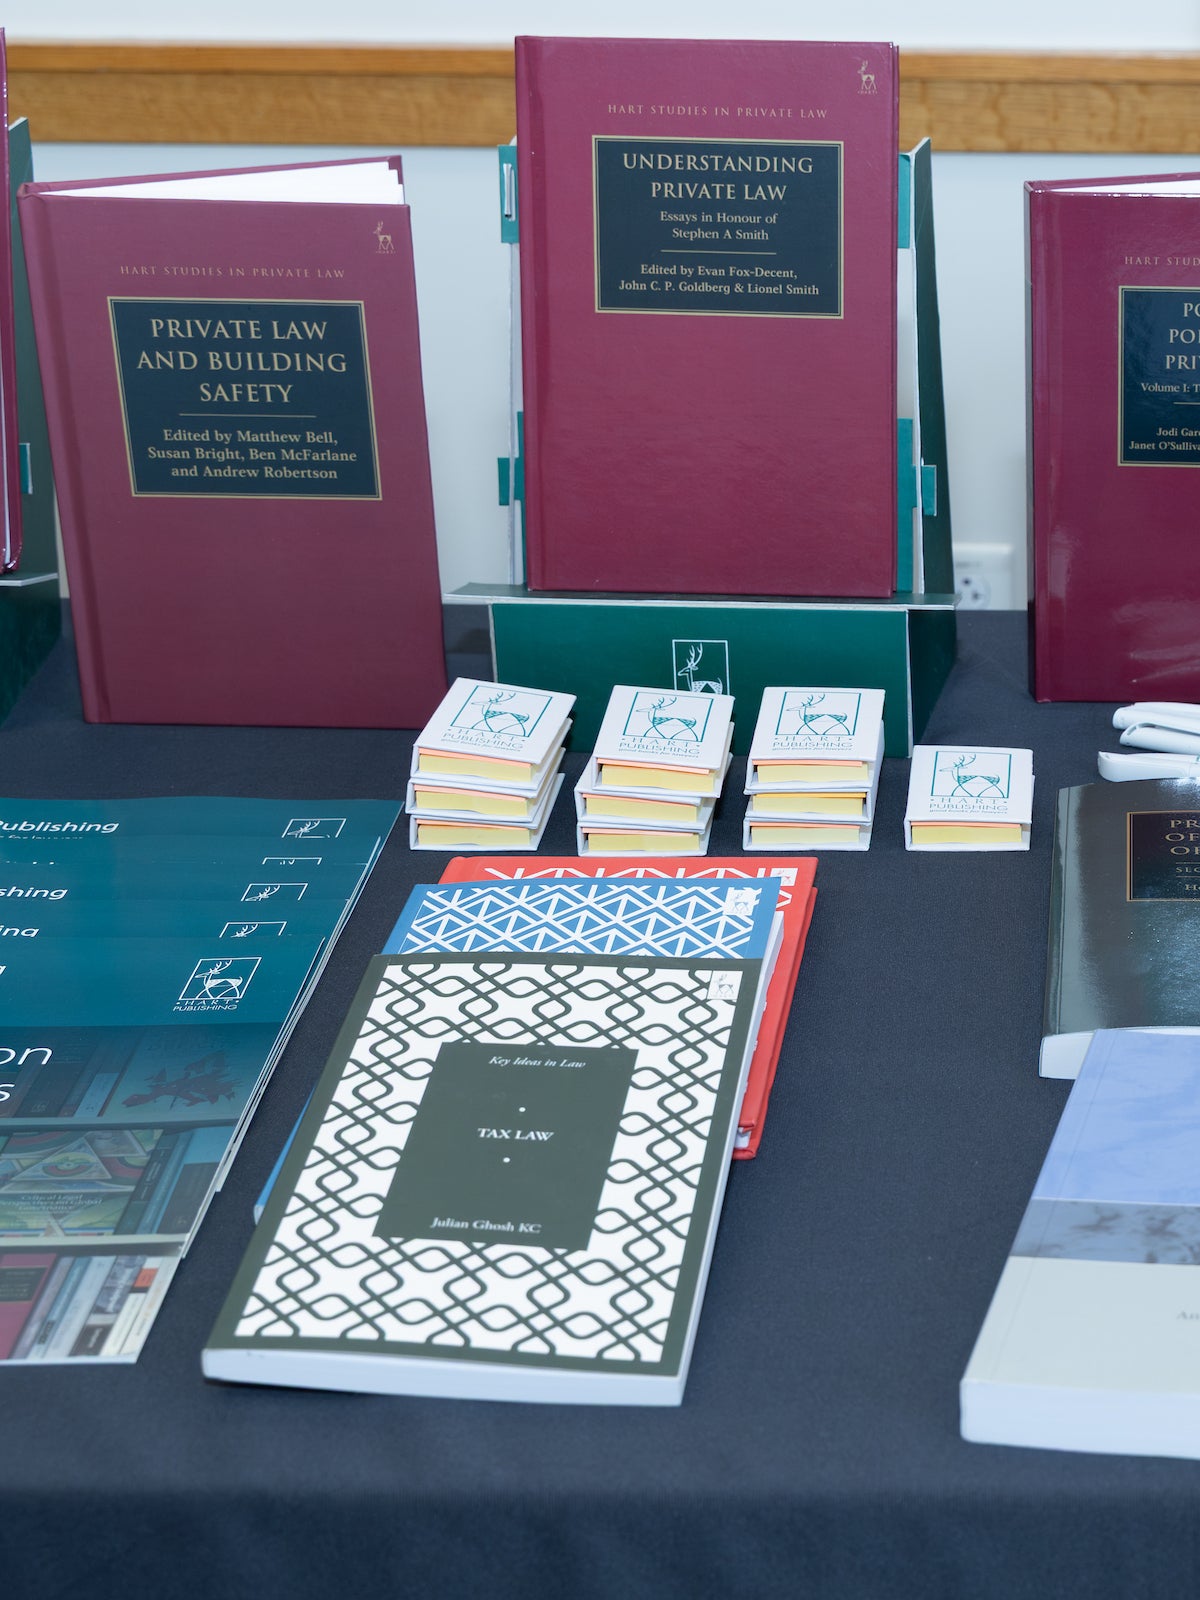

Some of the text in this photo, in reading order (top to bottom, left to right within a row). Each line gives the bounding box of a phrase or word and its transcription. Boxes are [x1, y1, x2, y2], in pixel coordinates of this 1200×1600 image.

[608, 105, 827, 118] HART STUDIES IN PRIVATE LAW
[623, 153, 814, 174] UNDERSTANDING
[651, 182, 786, 200] PRIVATE LAW
[660, 210, 778, 224] Essays in Honour of
[672, 227, 769, 241] Stephen A Smith
[640, 264, 798, 279] Edited by Evan Fox-Decent,
[619, 280, 819, 296] John C. P. Goldberg & Lionel Smith
[151, 318, 327, 341] PRIVATE LAW
[137, 352, 347, 374] AND BUILDING
[201, 383, 293, 404] SAFETY
[1141, 382, 1179, 393] Volume
[1183, 384, 1190, 393] I:
[163, 429, 338, 446] Edited by Matthew Bell,
[1156, 427, 1177, 437] Jodi
[1129, 440, 1156, 450] Janet
[148, 448, 357, 465] Susan Bright, Ben McFarlane
[171, 465, 338, 480] and Andrew Robertson
[489, 1056, 586, 1069] Key Ideas in Law
[477, 1128, 554, 1141] TAX LAW
[430, 1217, 542, 1233] Julian Ghosh KC
[1176, 1311, 1200, 1321] An
